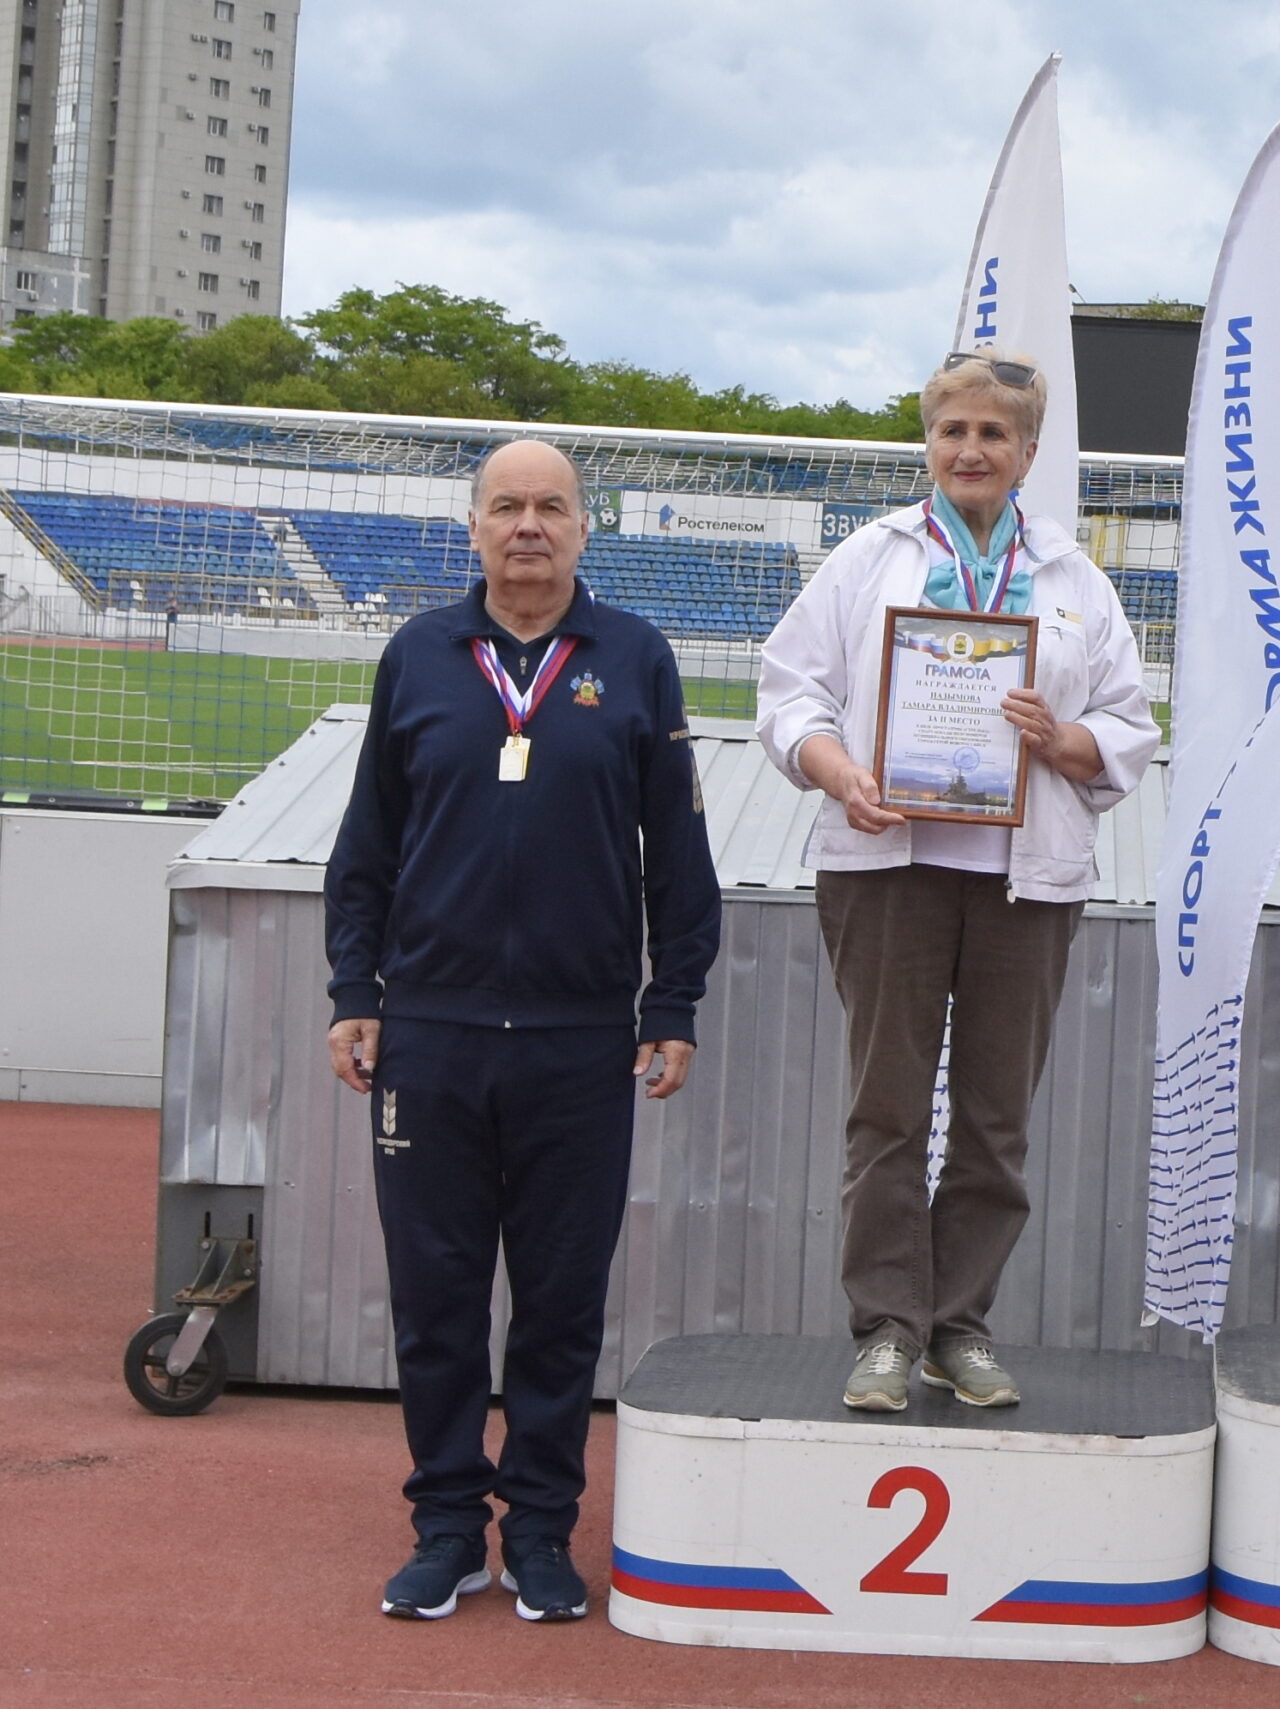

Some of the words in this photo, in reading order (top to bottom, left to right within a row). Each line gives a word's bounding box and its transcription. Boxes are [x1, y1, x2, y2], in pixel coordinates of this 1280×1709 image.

[1224, 316, 1266, 537] ЖИЗНИ
[678, 516, 765, 532] Ростелеком
[925, 664, 991, 680] ГРАМОТА
[915, 680, 997, 692] НАГРАЖДАЕТСЯ
[902, 701, 936, 710] ТАМАРА
[948, 717, 981, 726] МЕСТО
[860, 1466, 951, 1595] 2
